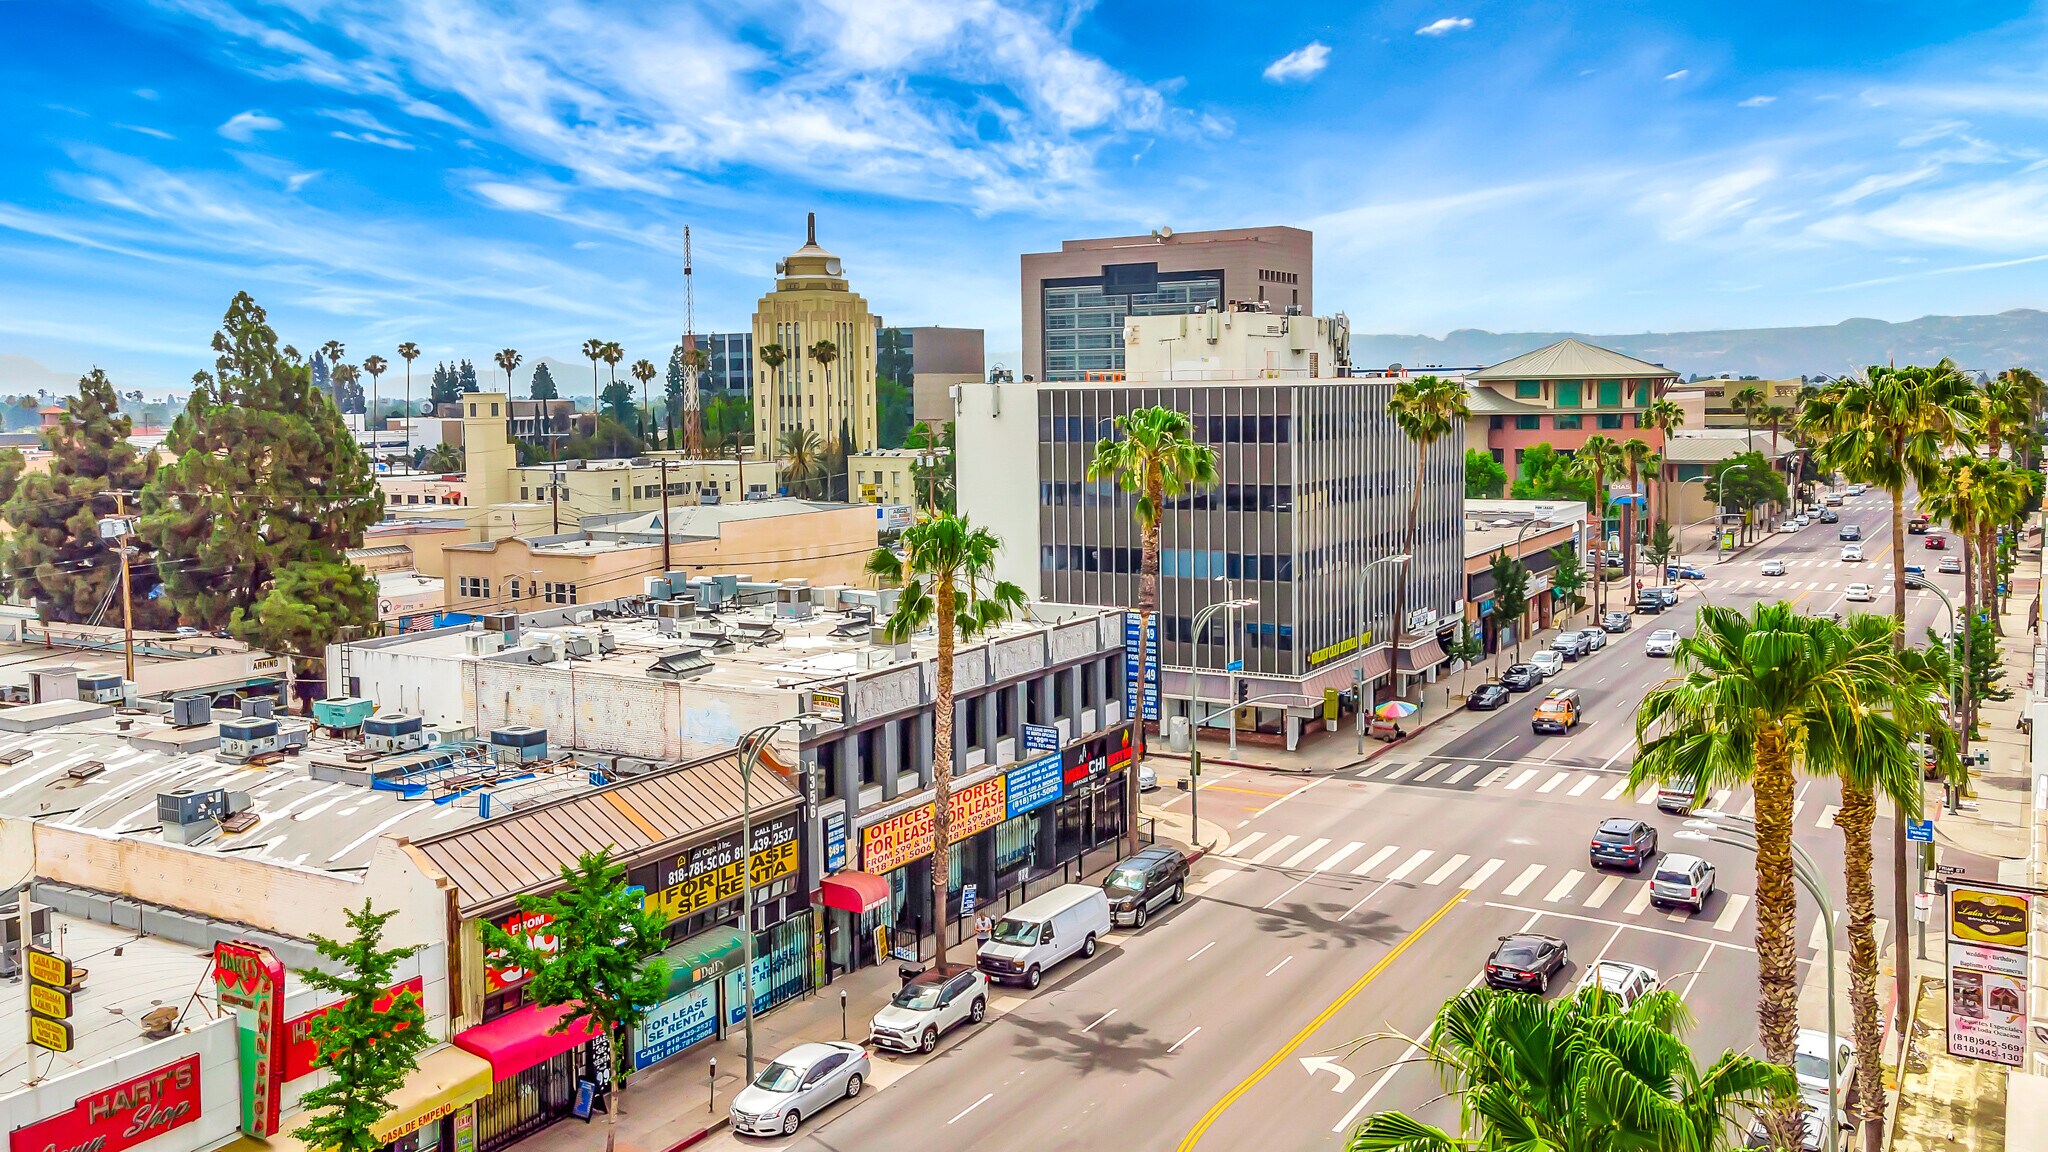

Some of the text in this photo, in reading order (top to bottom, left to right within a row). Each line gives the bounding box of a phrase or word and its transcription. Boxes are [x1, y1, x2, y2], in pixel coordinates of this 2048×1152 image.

[808, 760, 816, 819] 6356
[949, 778, 999, 809] STORES
[870, 805, 930, 839] OFFICES
[949, 806, 965, 825] OR
[968, 790, 1004, 817] LEASE
[967, 814, 983, 826] $99
[984, 810, 992, 818] &
[993, 805, 1004, 815] UP
[734, 827, 794, 859] 81-439-2537
[754, 822, 783, 837] CALL ELI
[866, 835, 893, 859] FOR
[896, 818, 934, 847] LEASE
[950, 815, 1002, 842] 18-781-5006
[866, 833, 934, 868] FROM $99 & UP
[869, 844, 932, 875] 818-781-5006
[665, 842, 794, 905] FOR LEASE
[677, 861, 788, 914] SE RENTA
[1965, 950, 2018, 964] Wedding Birthdays
[672, 997, 708, 1021] LEASE
[648, 1010, 705, 1042] SE RENTA
[640, 1045, 664, 1058] CALL:
[651, 1051, 664, 1062] ELI
[122, 1099, 191, 1139] Shop
[381, 1126, 403, 1144] CASA
[405, 1119, 416, 1132] DE
